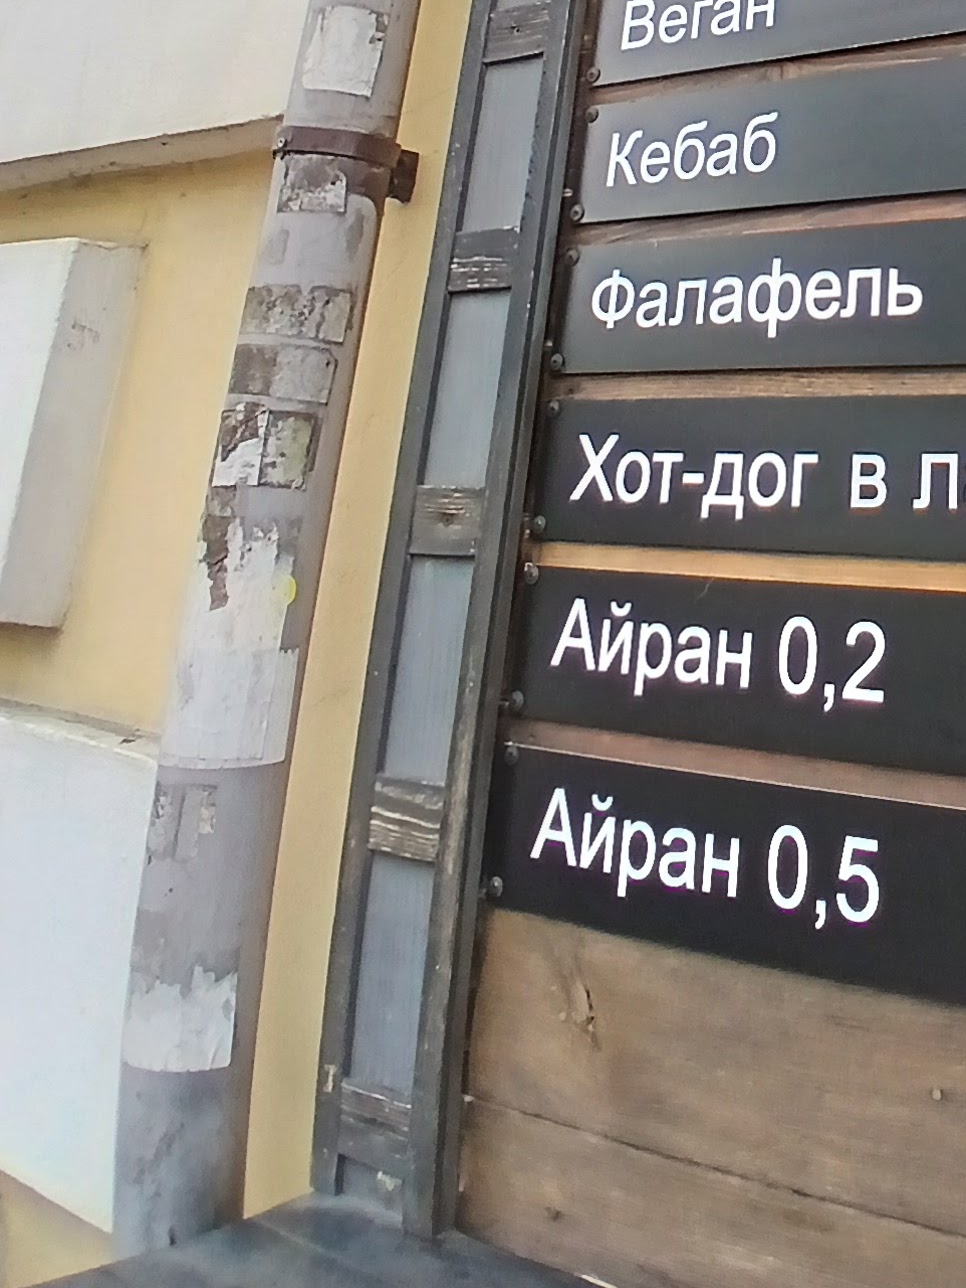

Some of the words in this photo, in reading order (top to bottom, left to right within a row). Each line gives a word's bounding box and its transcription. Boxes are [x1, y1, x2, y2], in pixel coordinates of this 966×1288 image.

[605, 112, 780, 188] Кебаб
[591, 258, 924, 338] Фалафель
[570, 434, 819, 520] Хот-дог
[850, 452, 888, 509] в
[549, 597, 753, 696] Айран
[778, 616, 888, 712] 0,2
[530, 786, 740, 899] Айран
[767, 824, 881, 931] 0,5
